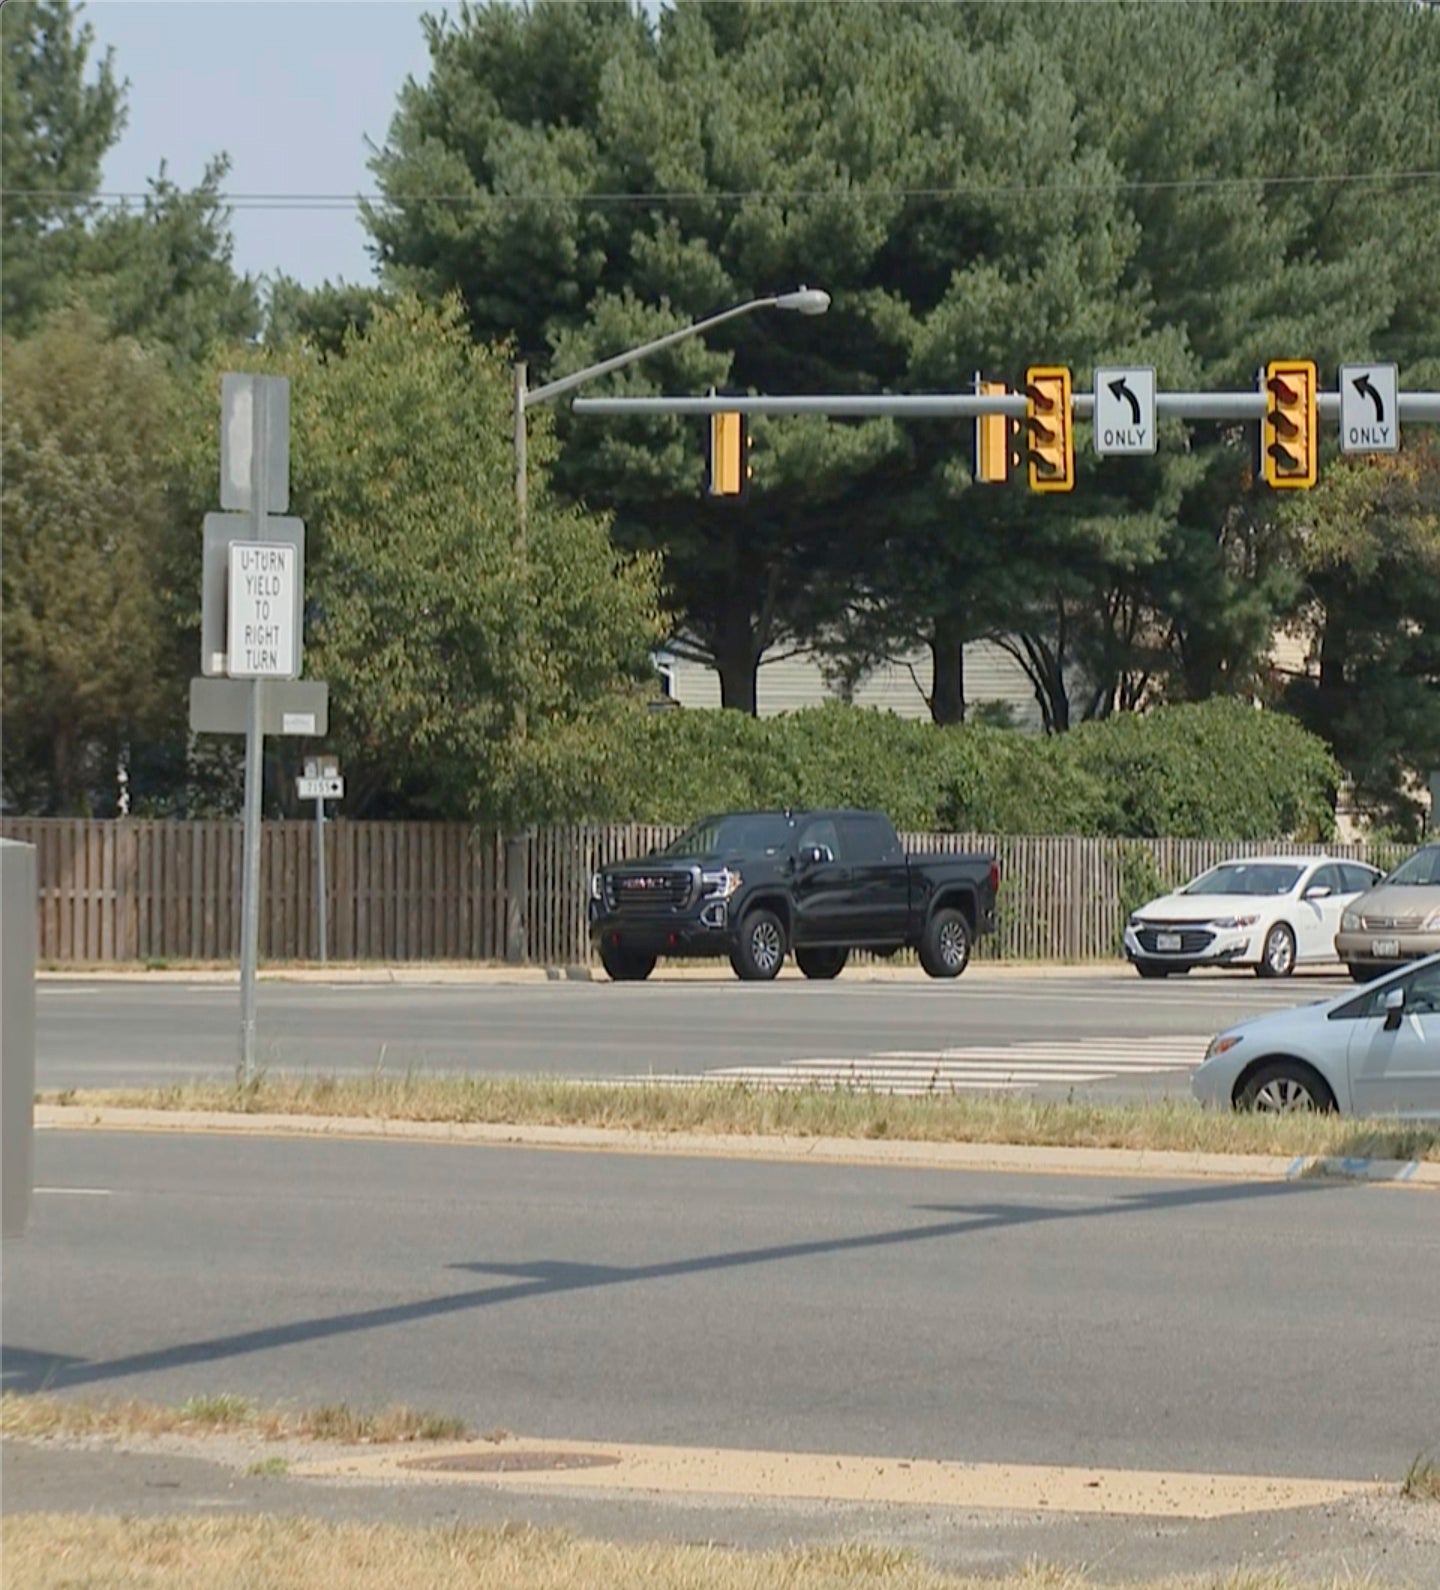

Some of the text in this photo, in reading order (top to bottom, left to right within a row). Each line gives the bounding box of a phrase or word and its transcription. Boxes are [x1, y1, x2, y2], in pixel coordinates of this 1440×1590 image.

[1104, 429, 1146, 446] ONLY
[1349, 427, 1389, 444] ONLY
[241, 551, 286, 571] U-TURN
[246, 575, 280, 596] YIELD
[255, 600, 270, 620] TO
[245, 625, 280, 645] RIGHT
[246, 650, 278, 670] TURN
